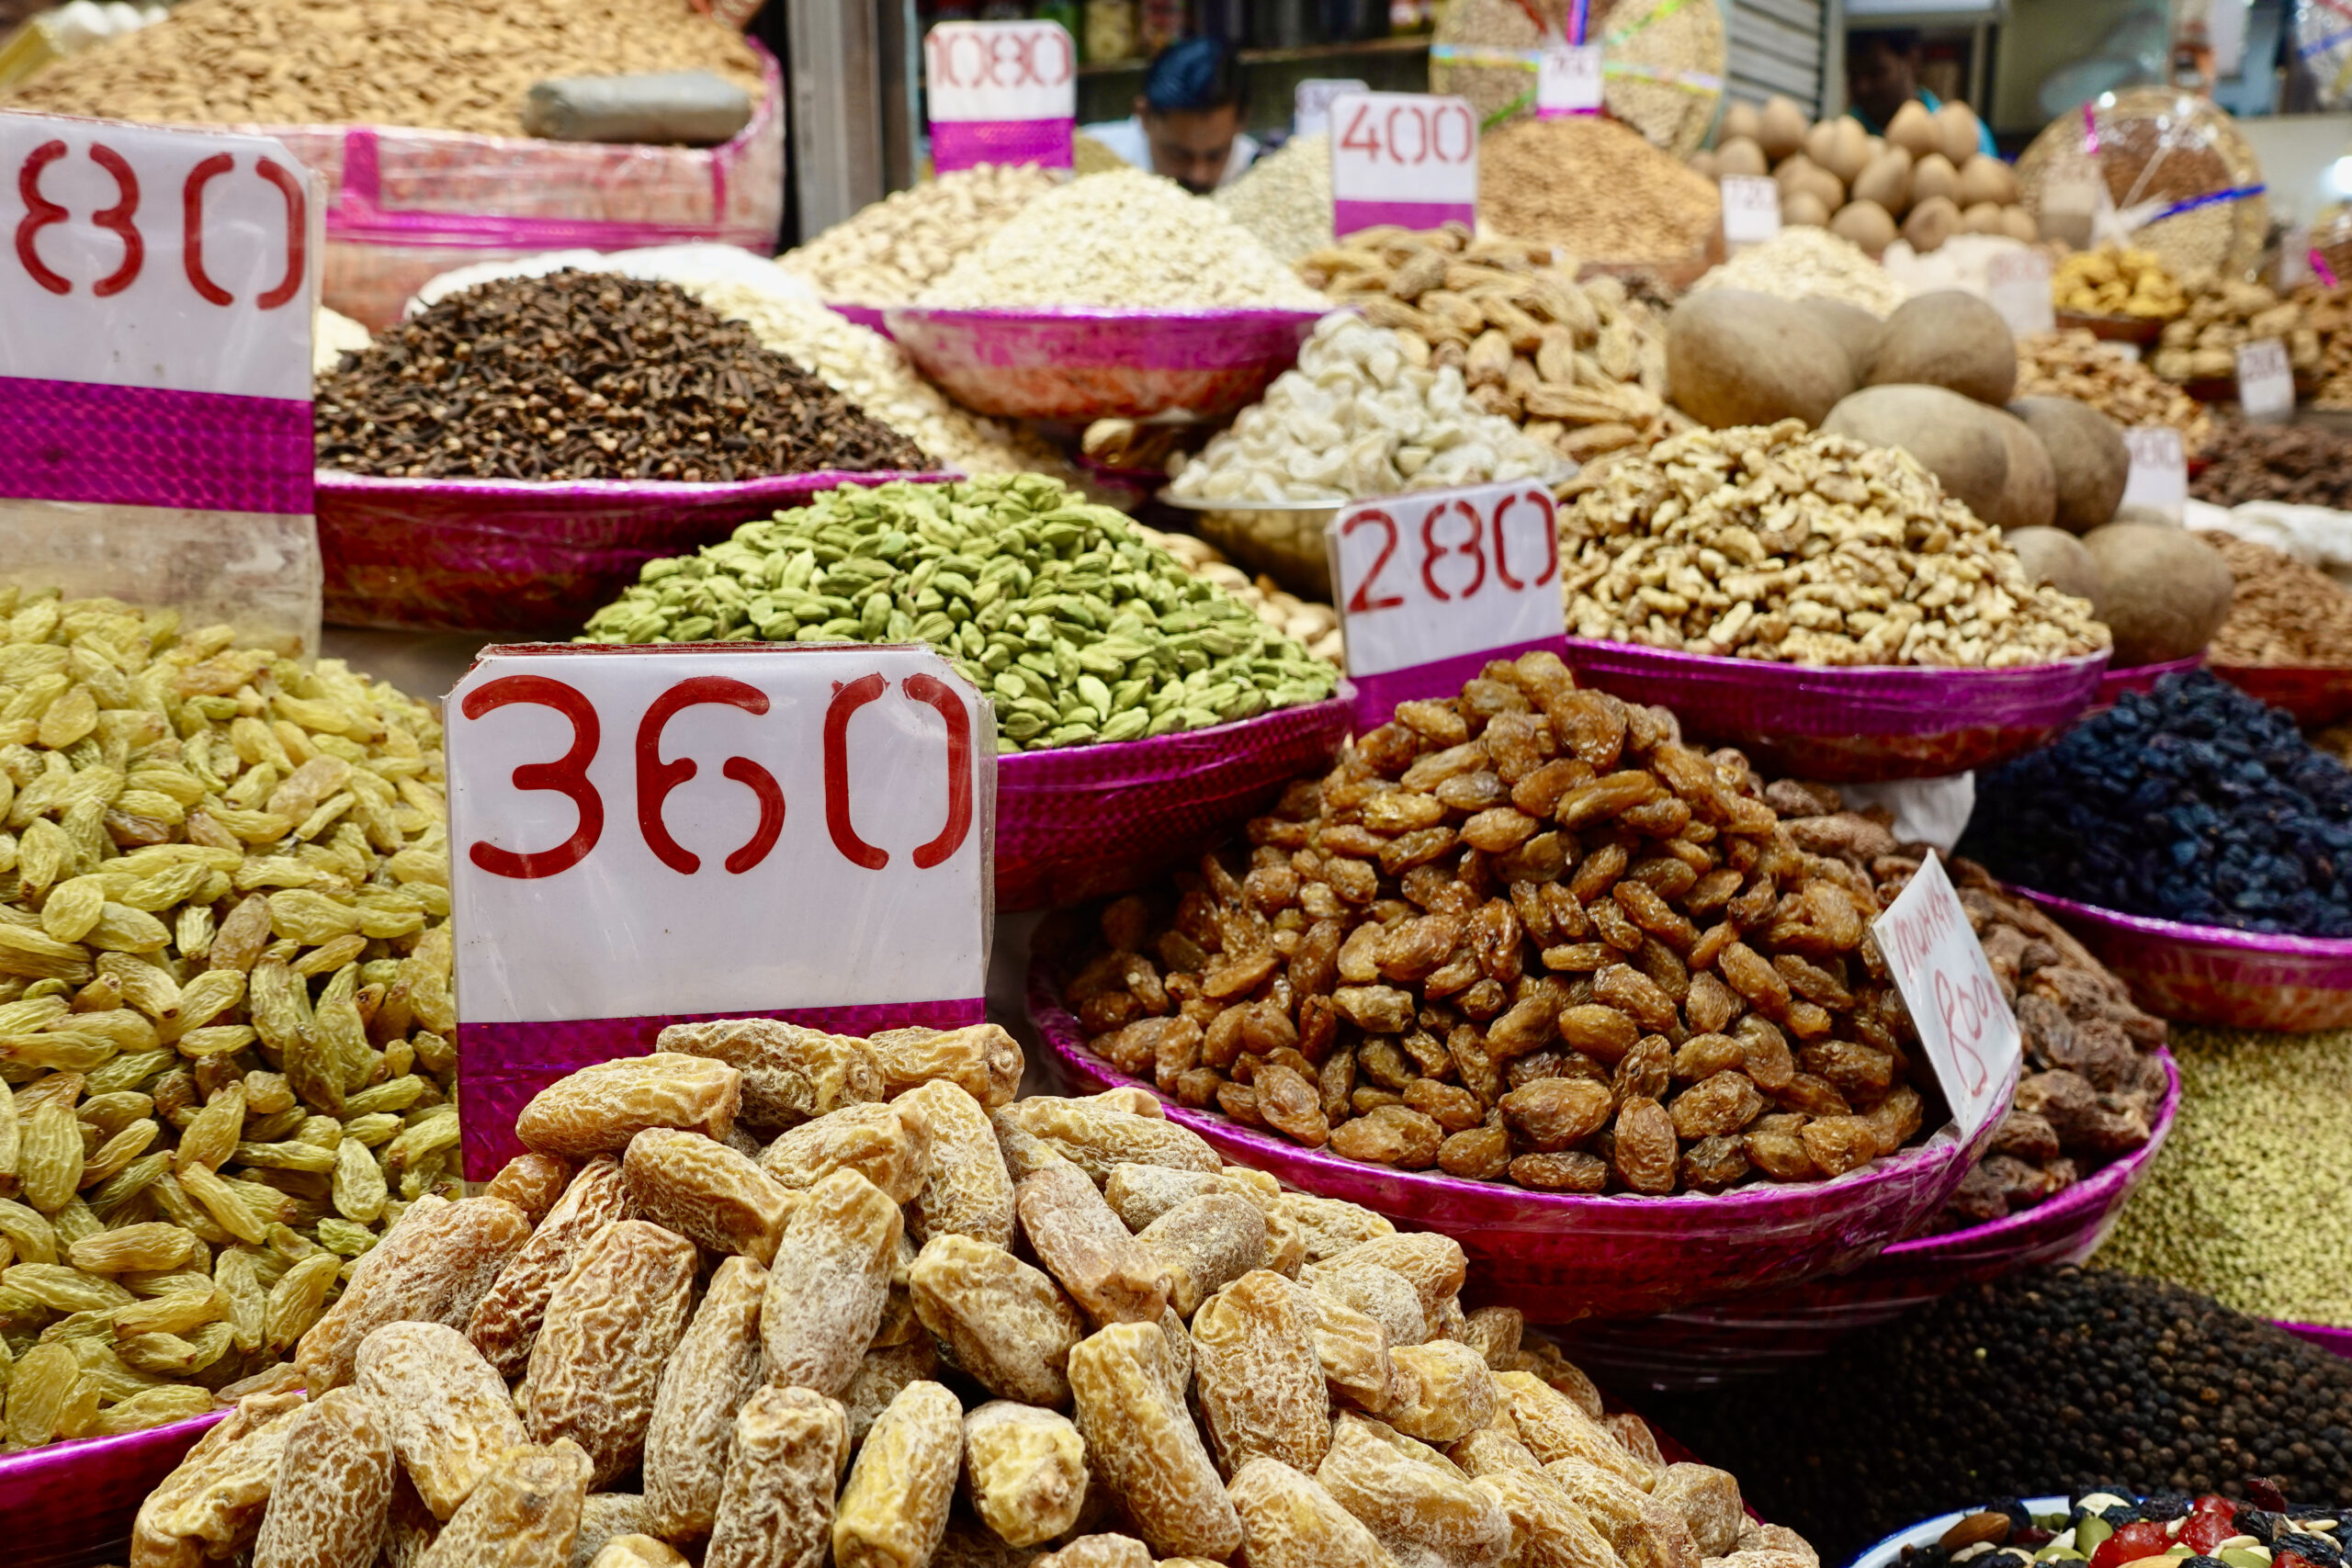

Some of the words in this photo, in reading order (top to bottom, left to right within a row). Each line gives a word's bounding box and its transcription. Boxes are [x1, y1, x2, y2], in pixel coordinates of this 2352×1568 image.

[925, 31, 1071, 88] 1080
[1340, 103, 1474, 164] 400
[15, 139, 306, 310] 80
[1341, 490, 1558, 614] 280
[462, 671, 972, 880] 360
